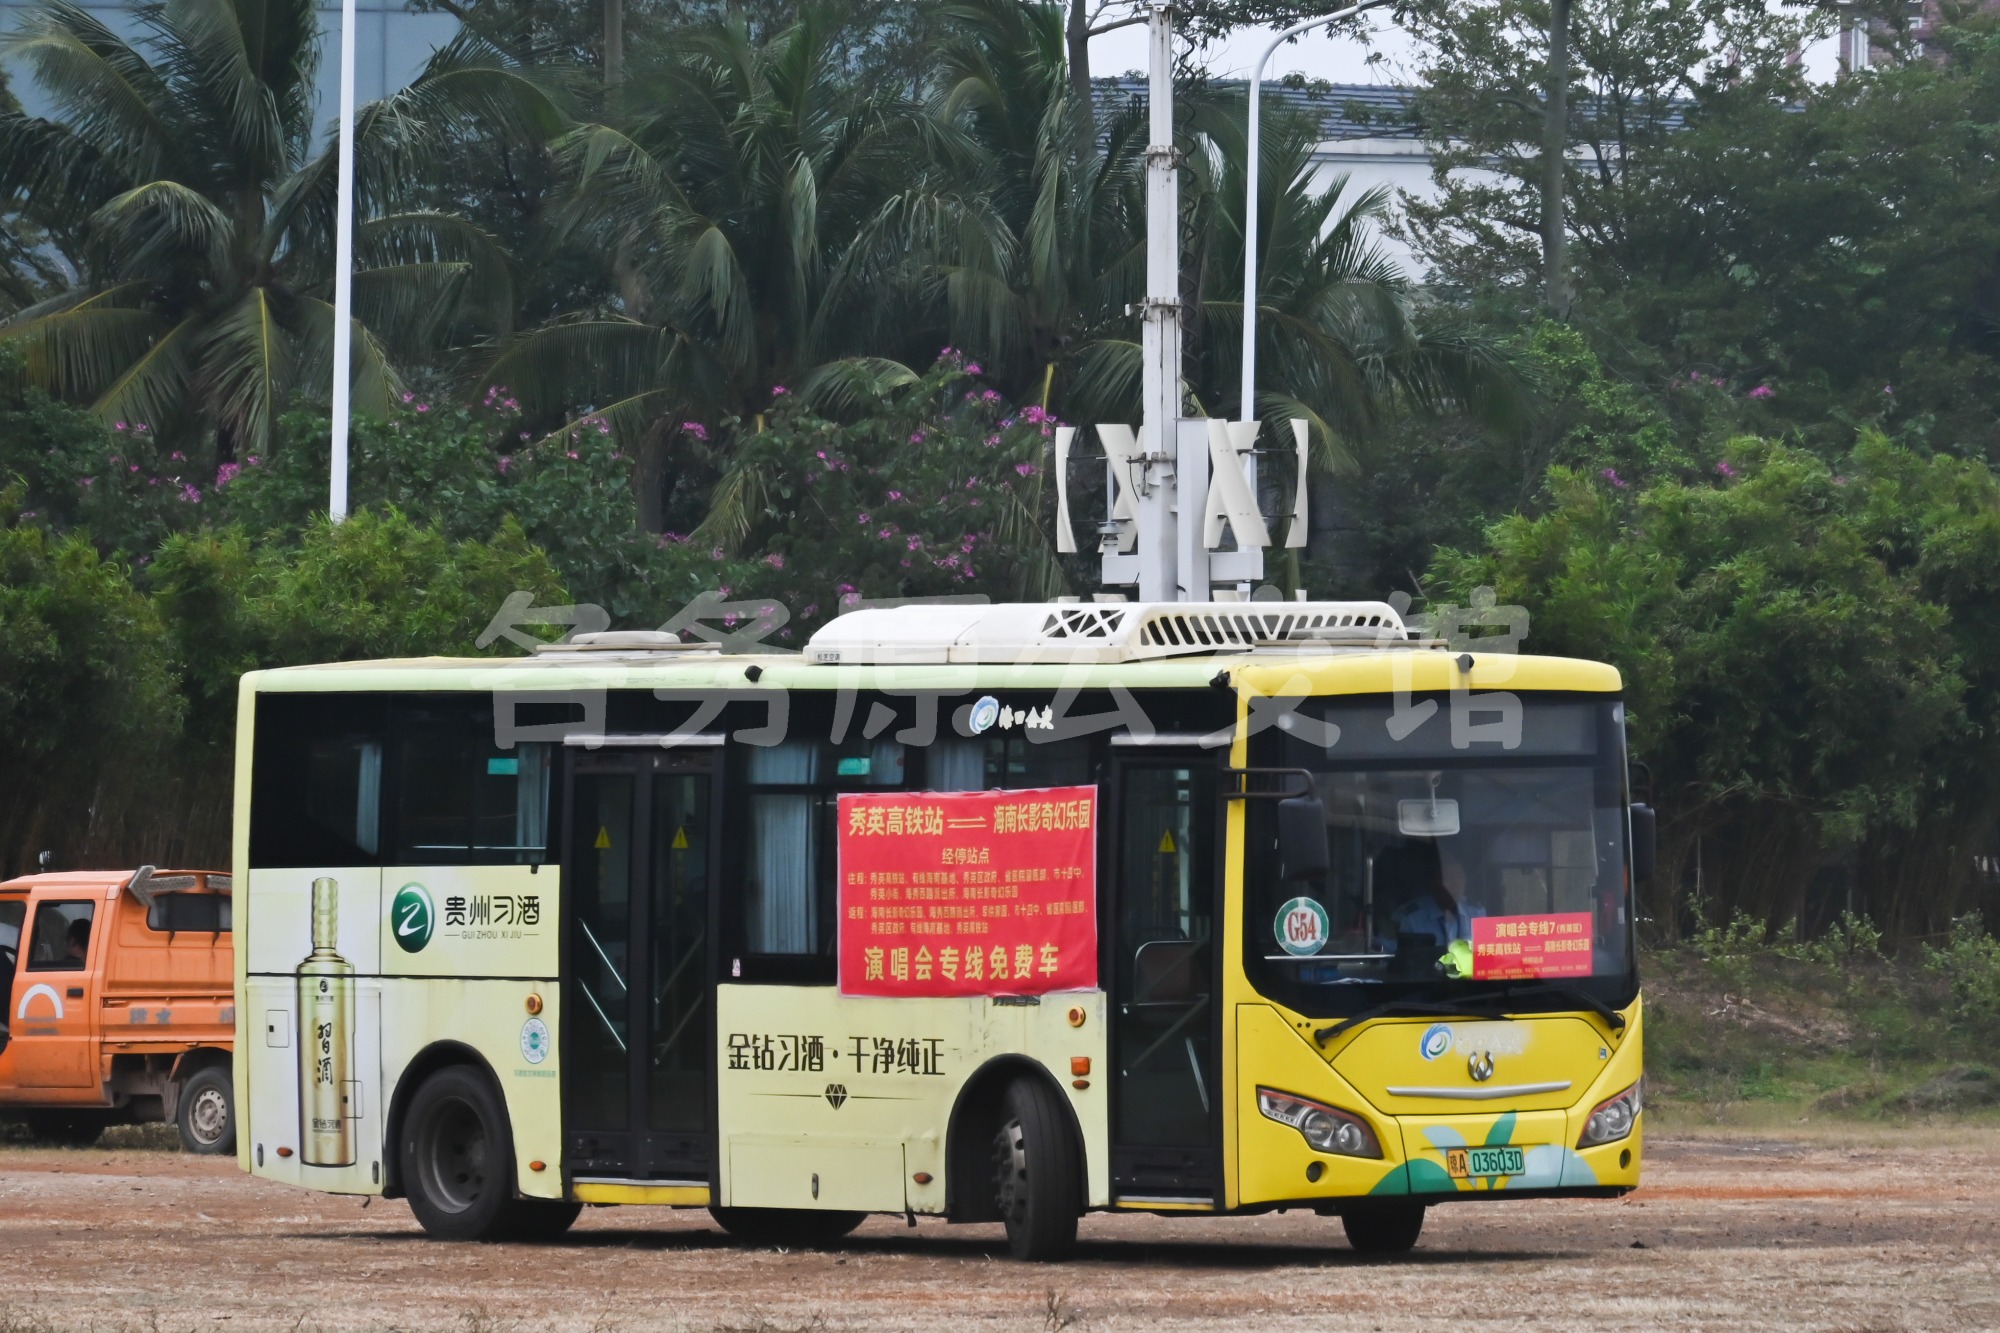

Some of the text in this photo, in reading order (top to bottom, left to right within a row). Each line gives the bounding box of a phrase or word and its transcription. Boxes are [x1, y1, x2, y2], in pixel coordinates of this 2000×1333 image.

[849, 799, 1091, 836] 秀英高铁站 海南长影奇幻乐园
[942, 847, 990, 865] 经停站点
[444, 894, 540, 926] 贵州习酒
[1288, 912, 1317, 942] G54
[864, 943, 1060, 981] 演唱会专线免费车
[1477, 942, 1522, 956] 秀英高铁站
[1472, 1150, 1523, 1173] 03603D
